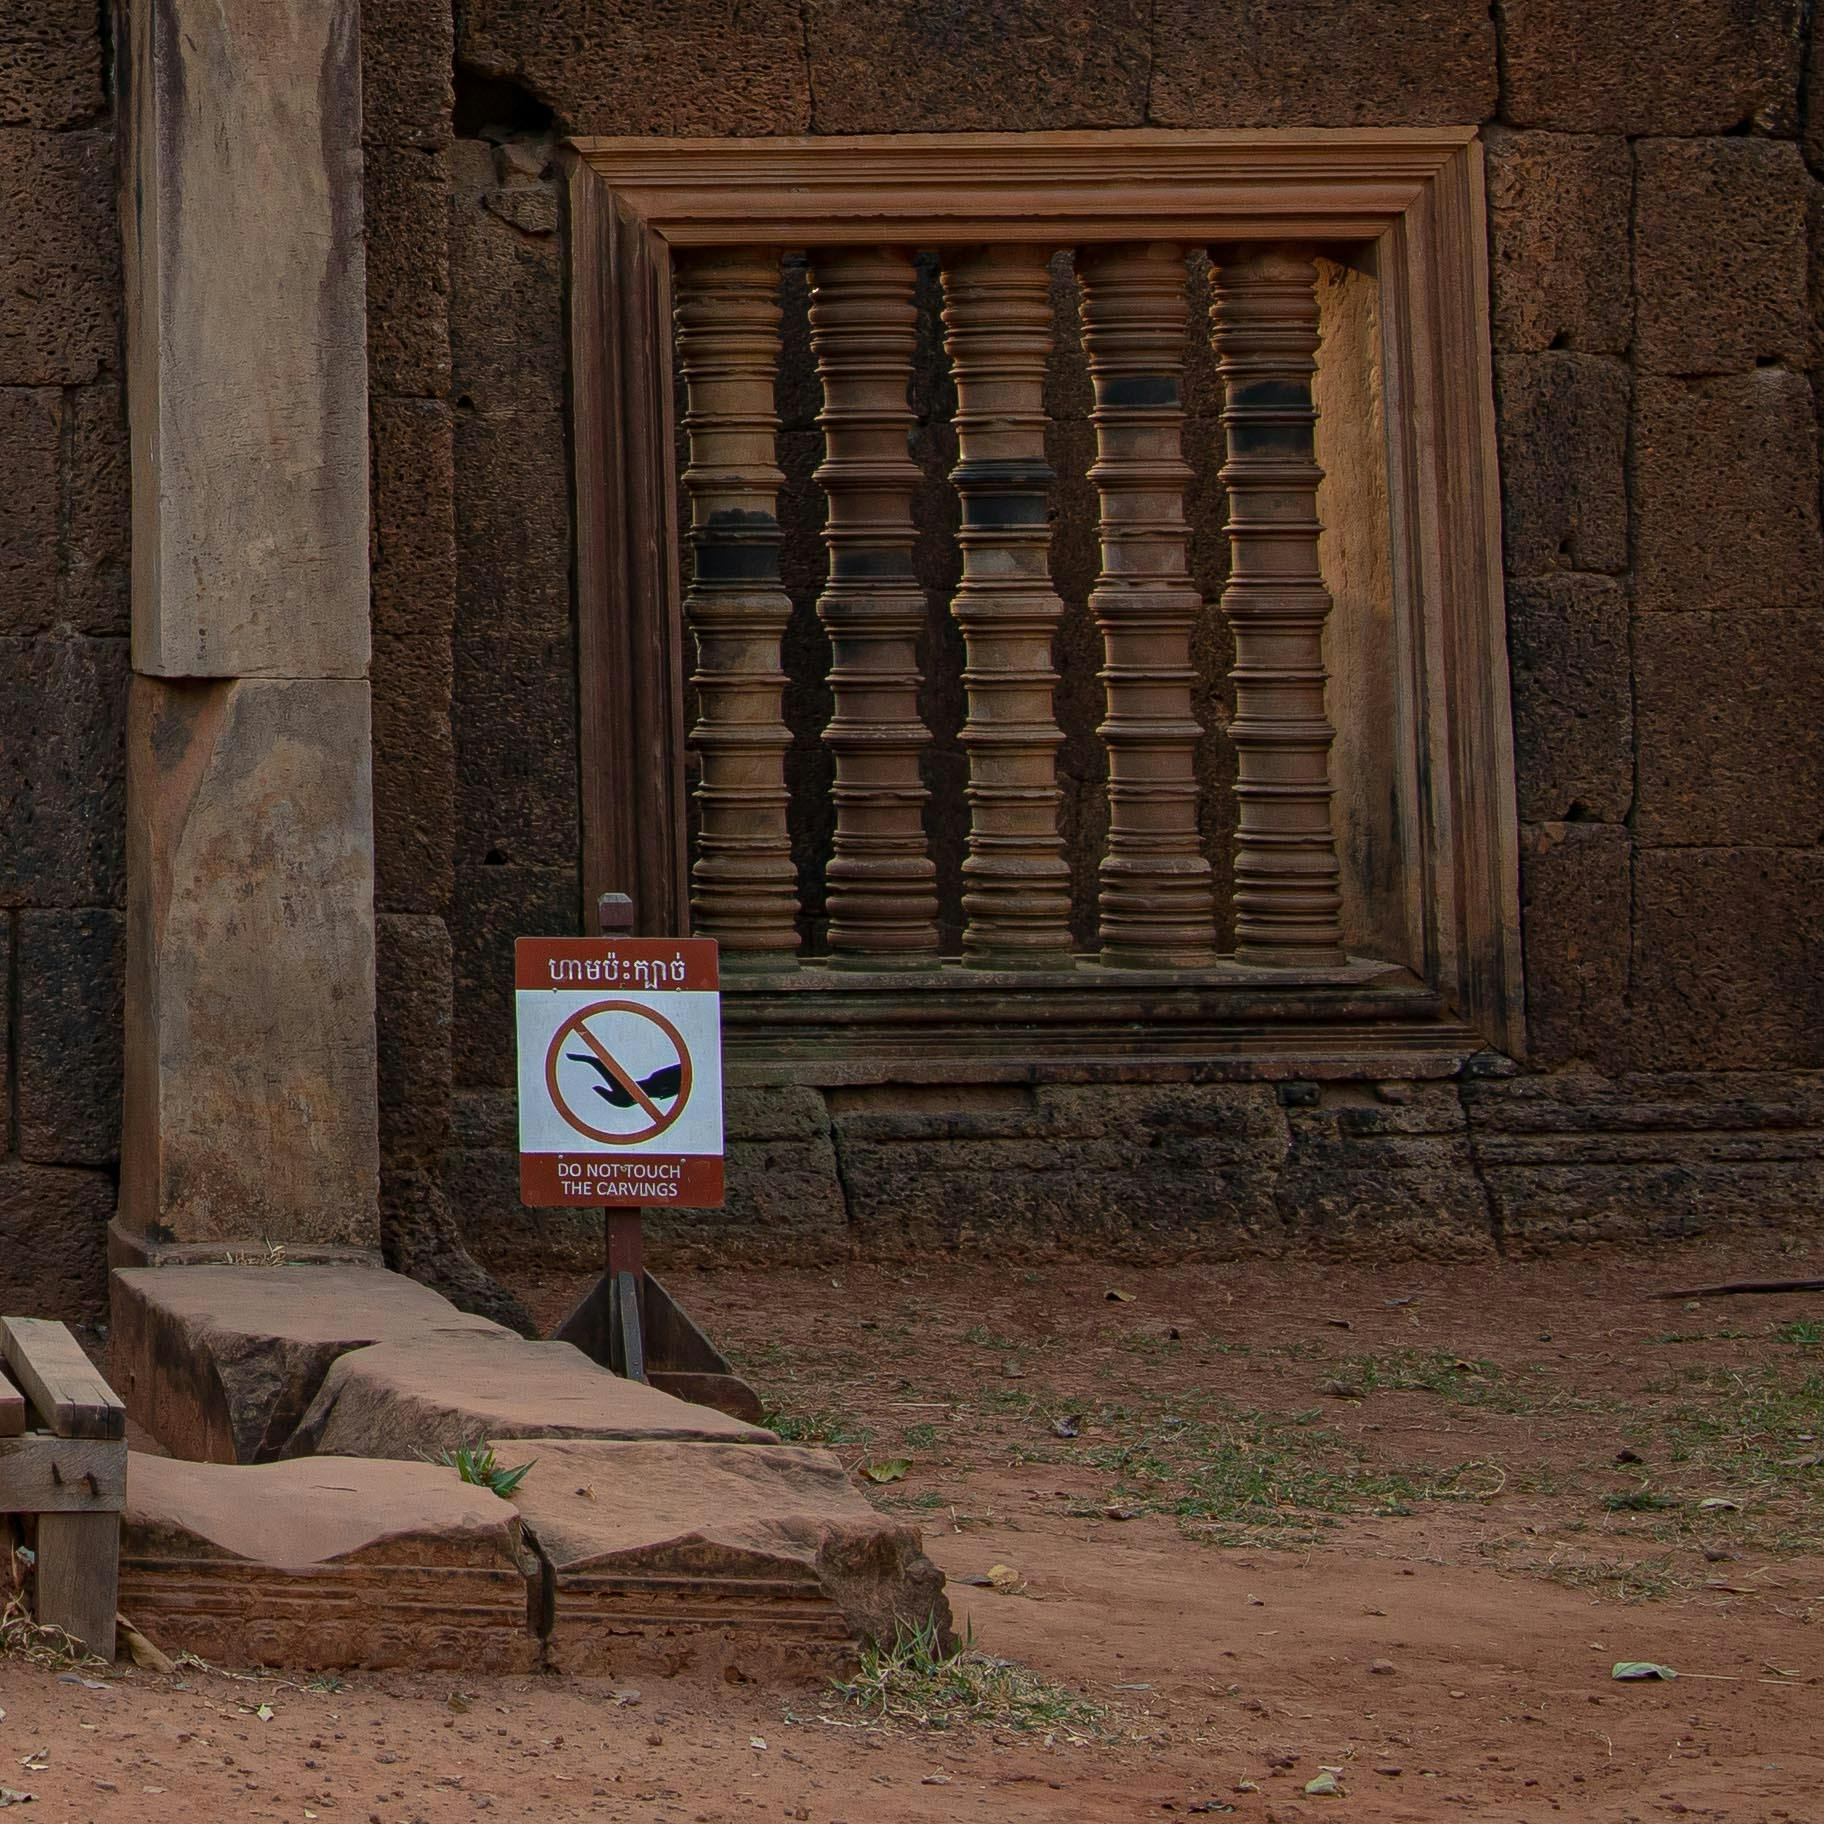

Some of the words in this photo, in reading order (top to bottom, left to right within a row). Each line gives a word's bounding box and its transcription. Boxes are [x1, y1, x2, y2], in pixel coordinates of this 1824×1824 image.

[558, 1163, 582, 1177] DO
[586, 1163, 620, 1178] NOT
[624, 1164, 681, 1179] TOUCH
[561, 1180, 592, 1195] THE
[596, 1181, 678, 1197] CARVINGS
